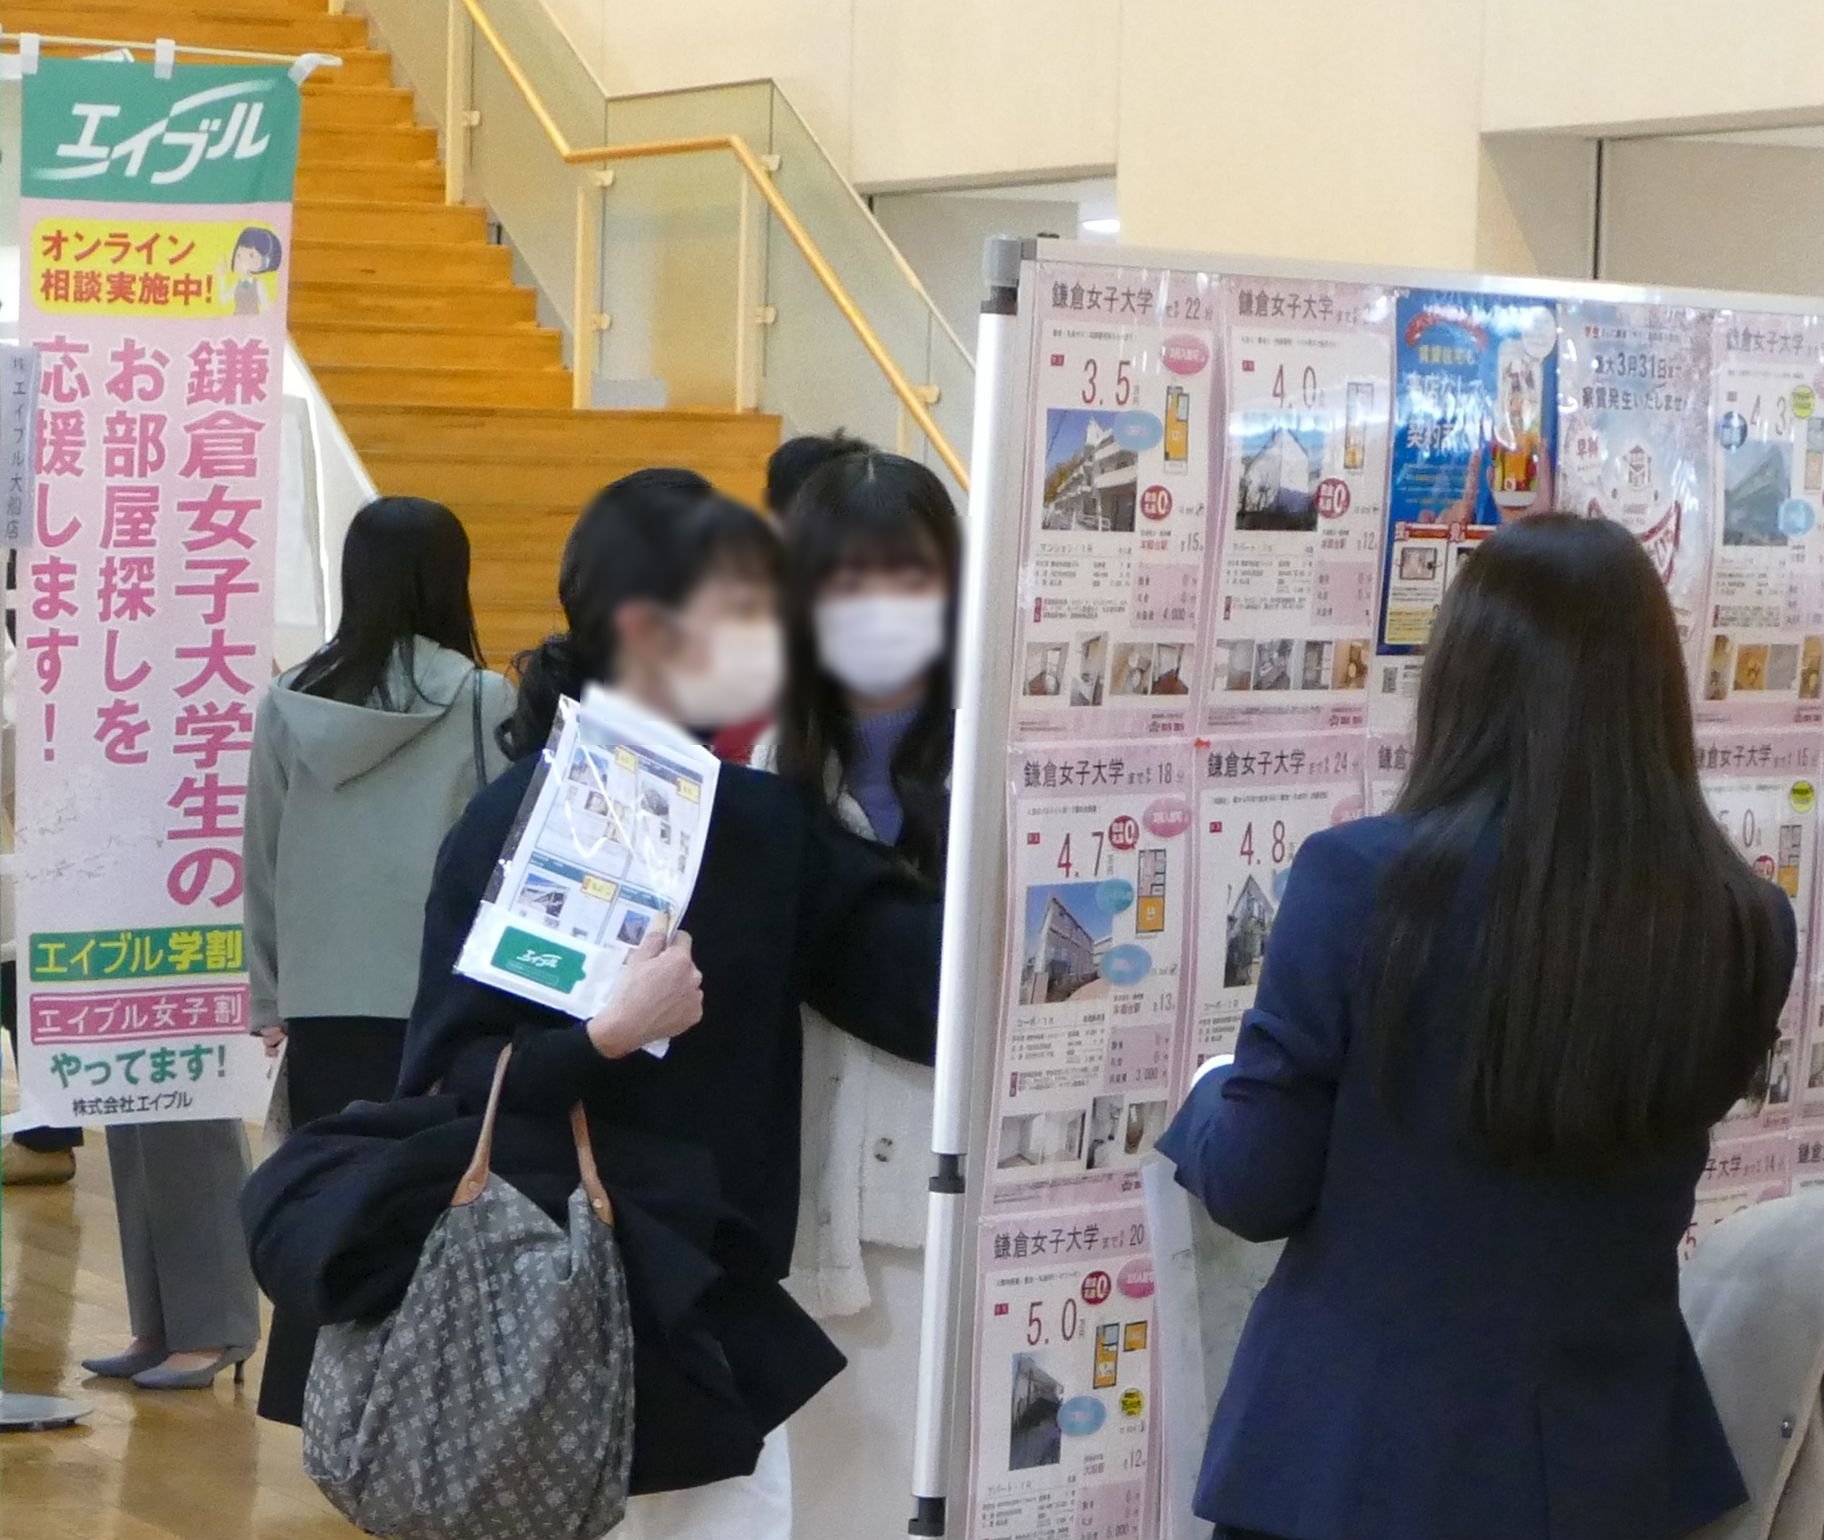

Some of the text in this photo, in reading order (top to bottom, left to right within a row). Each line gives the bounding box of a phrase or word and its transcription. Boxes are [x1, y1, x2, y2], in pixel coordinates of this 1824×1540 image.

[51, 95, 272, 184] エイブル
[41, 230, 195, 265] オンライン
[40, 268, 213, 305] 相談実施中!
[1081, 358, 1131, 406] 3.5
[1272, 364, 1317, 409] 4.0
[93, 337, 168, 765] お部屋探しを
[167, 339, 270, 908] 鎌倉女子大学生の
[1057, 831, 1105, 878] 4.7
[1240, 820, 1285, 866] 4.8
[35, 930, 243, 975] エイブル学割
[37, 993, 242, 1033] エイブル女子割
[50, 1044, 226, 1089] やってます!
[73, 1091, 193, 1116] 株式会社エイブル
[1026, 1297, 1077, 1346] 5.0
